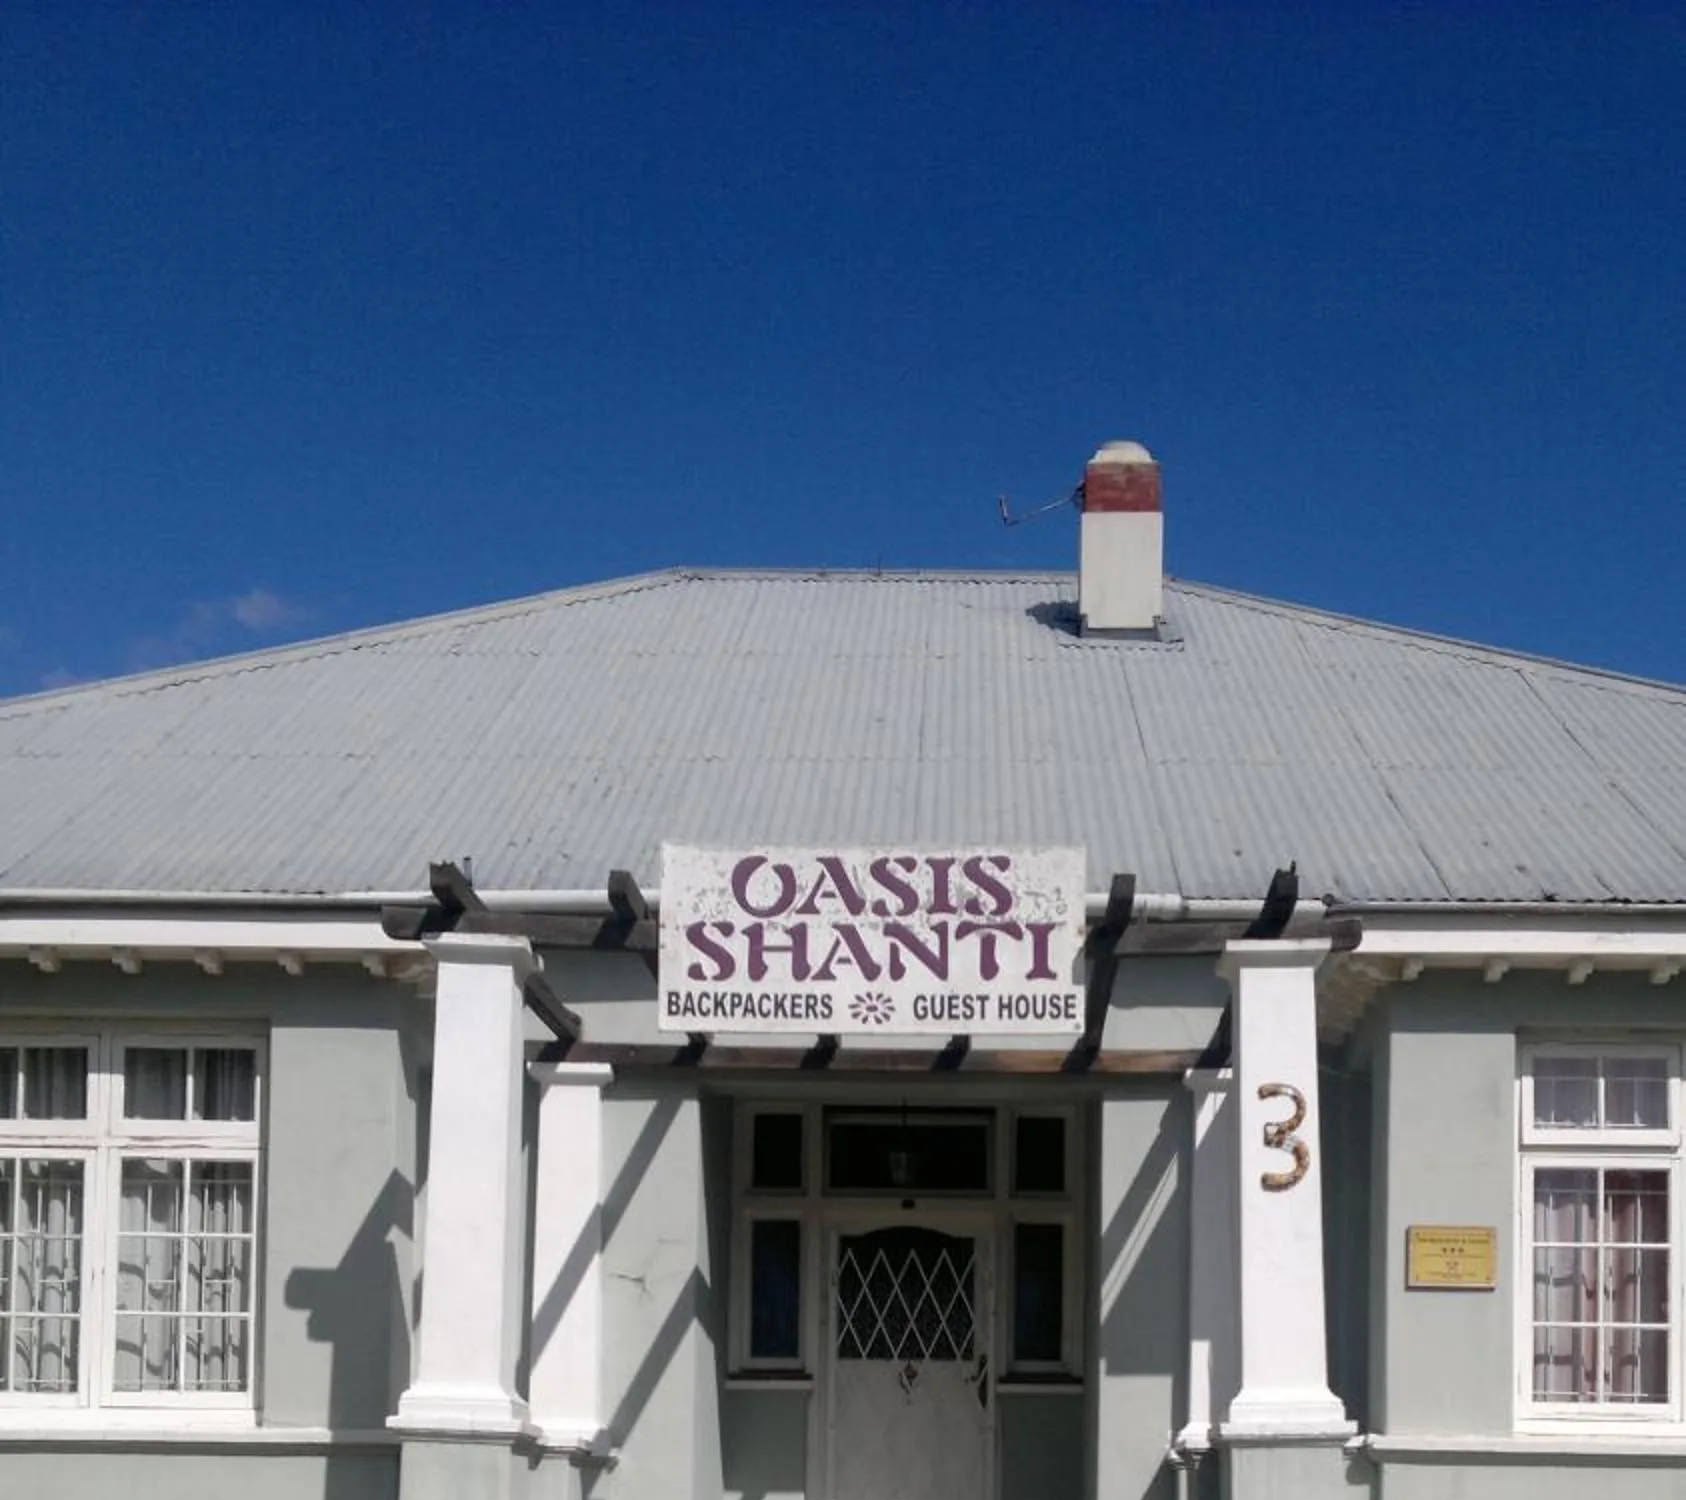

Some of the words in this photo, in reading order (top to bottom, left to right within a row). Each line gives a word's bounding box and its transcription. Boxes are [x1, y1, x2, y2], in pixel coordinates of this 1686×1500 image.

[730, 855, 1013, 918] OASIS
[685, 920, 1058, 982] SHANTI
[667, 991, 834, 1019] BACKPACKERS
[913, 993, 991, 1021] GUEST
[998, 993, 1077, 1020] HOUSE
[1257, 1083, 1310, 1192] 3
